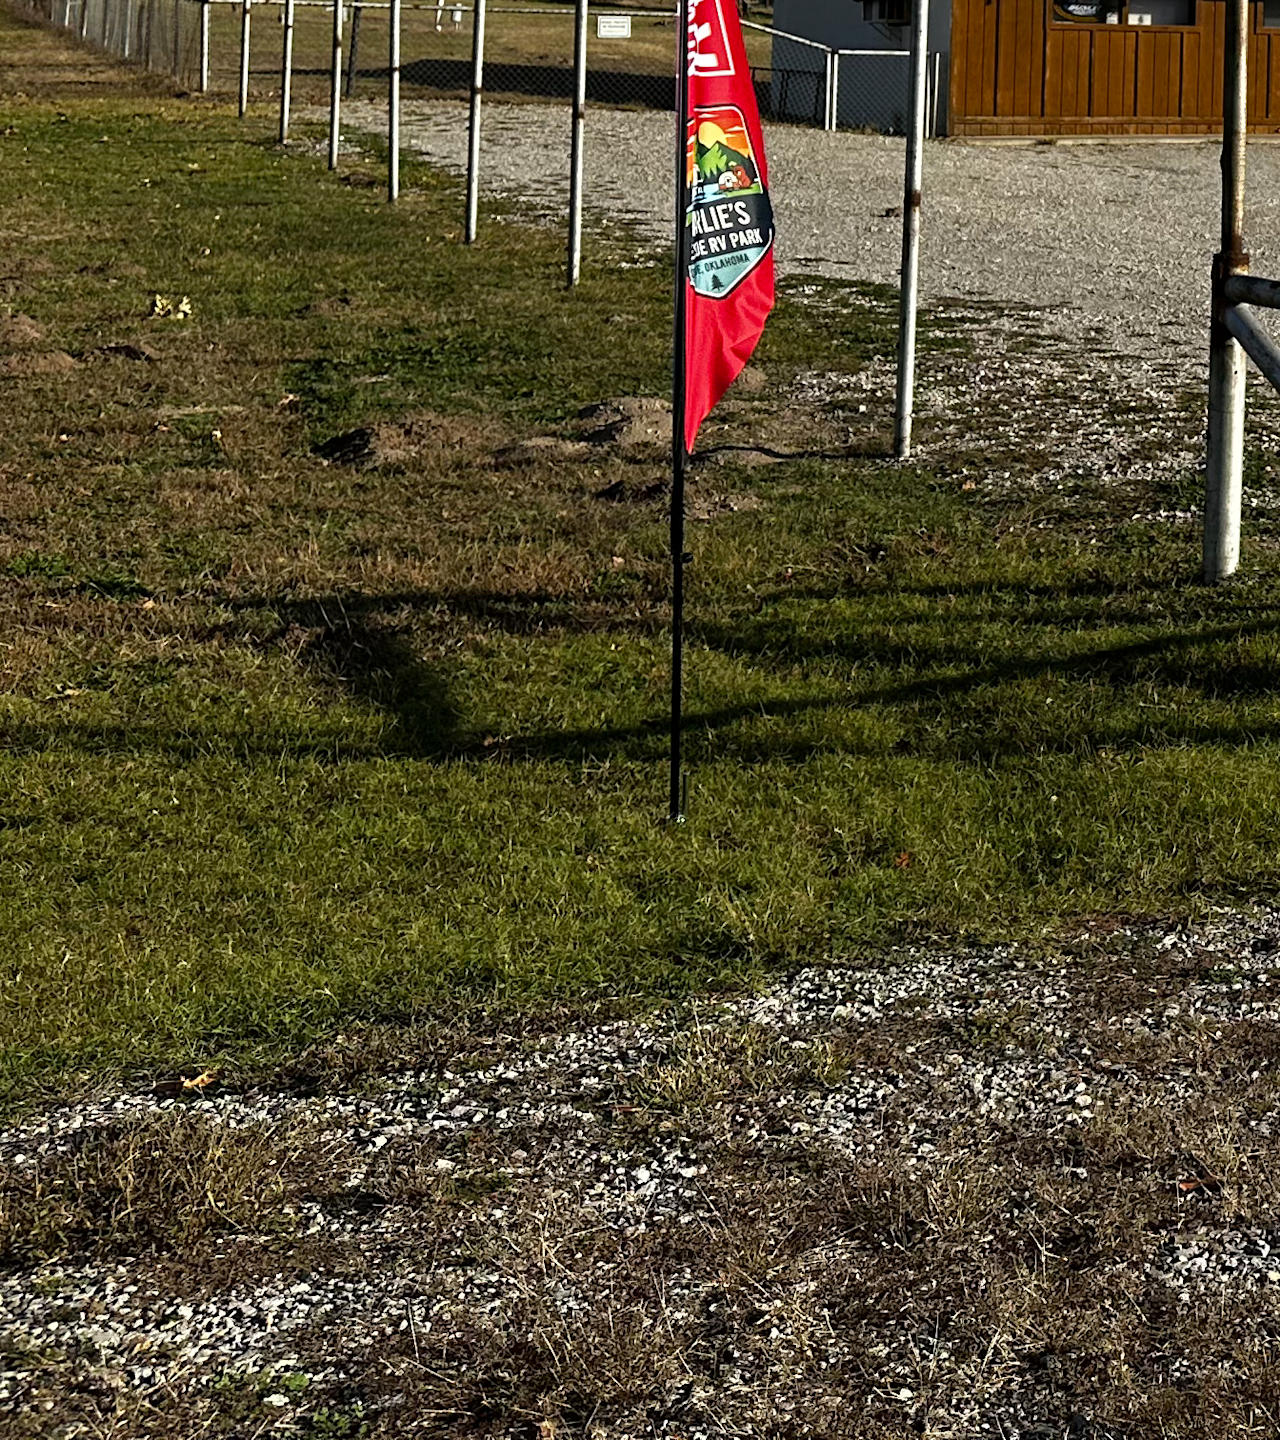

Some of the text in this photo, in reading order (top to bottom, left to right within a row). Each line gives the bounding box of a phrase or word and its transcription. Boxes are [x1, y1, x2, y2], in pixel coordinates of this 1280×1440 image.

[708, 235, 727, 253] RV
[729, 228, 763, 248] PARK
[705, 253, 750, 272] OKLAHOMA
